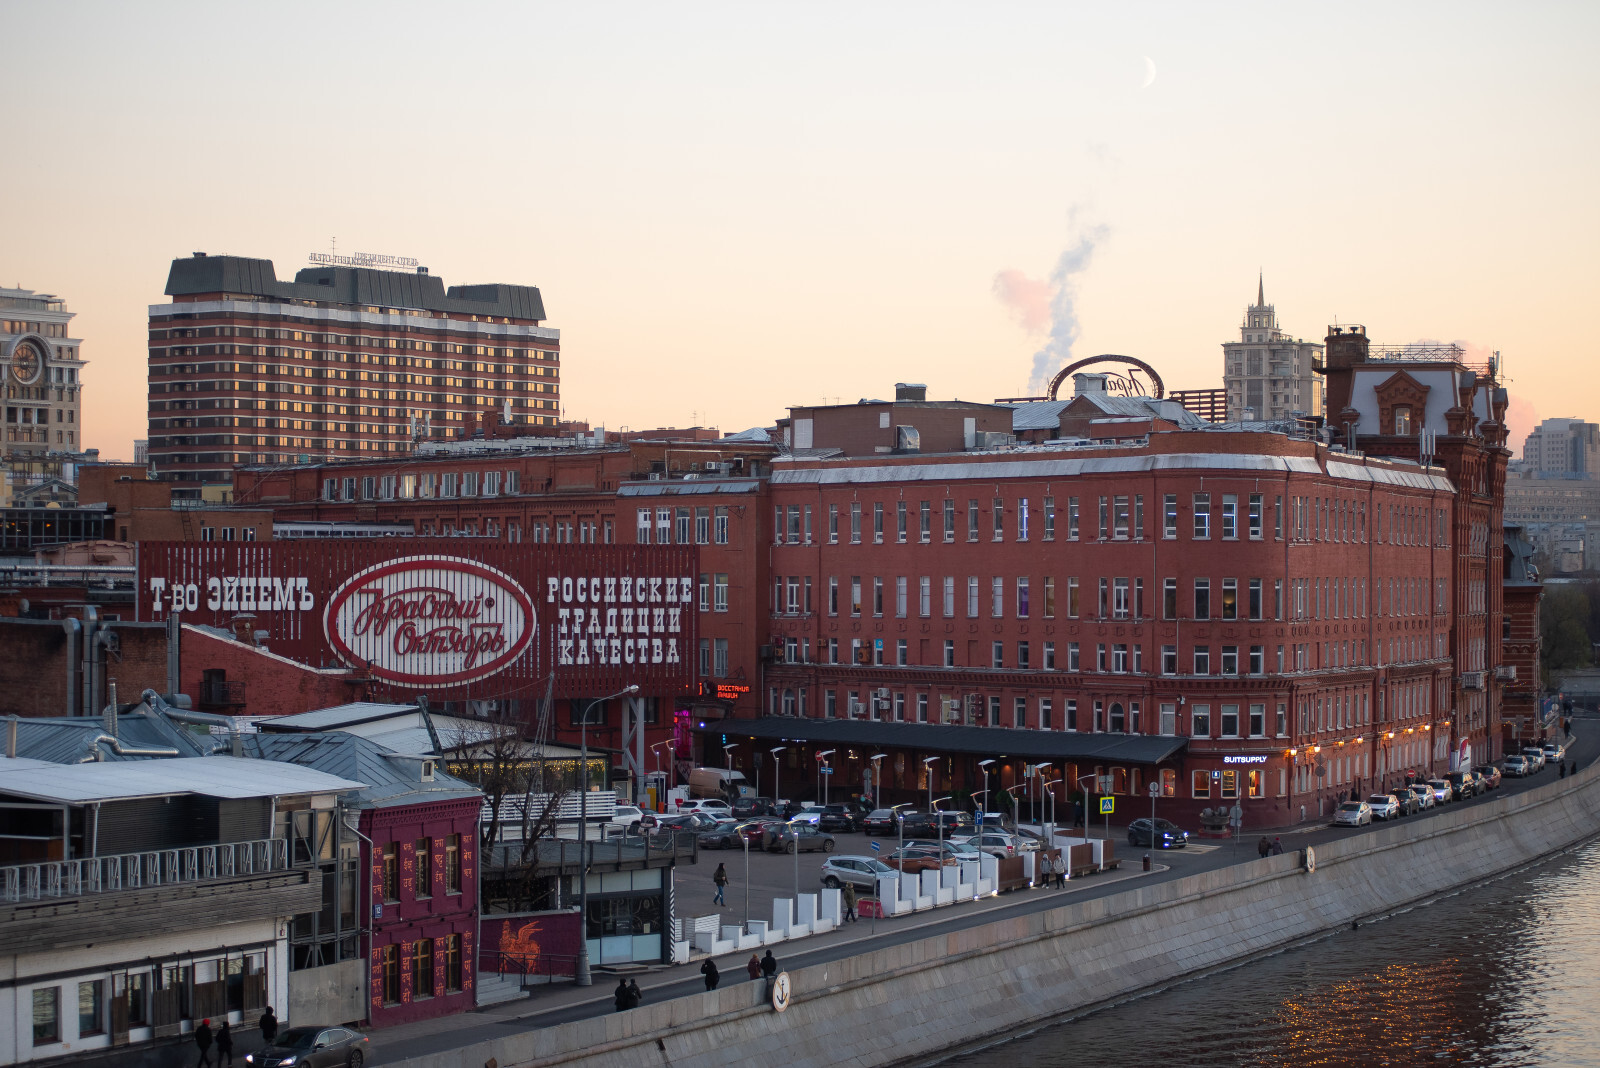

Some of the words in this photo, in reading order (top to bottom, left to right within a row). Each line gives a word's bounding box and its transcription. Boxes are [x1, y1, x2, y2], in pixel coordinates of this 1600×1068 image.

[207, 576, 314, 612] ЭЙНЕМЪ
[547, 576, 692, 603] РОССИЙСКИЕ
[353, 587, 484, 637] Красный
[559, 608, 681, 636] ТРАДИЦИИ
[394, 621, 508, 669] Октябрь
[559, 638, 680, 665] КАЧЕСТВА
[1223, 755, 1268, 764] SUITSUPPLY
